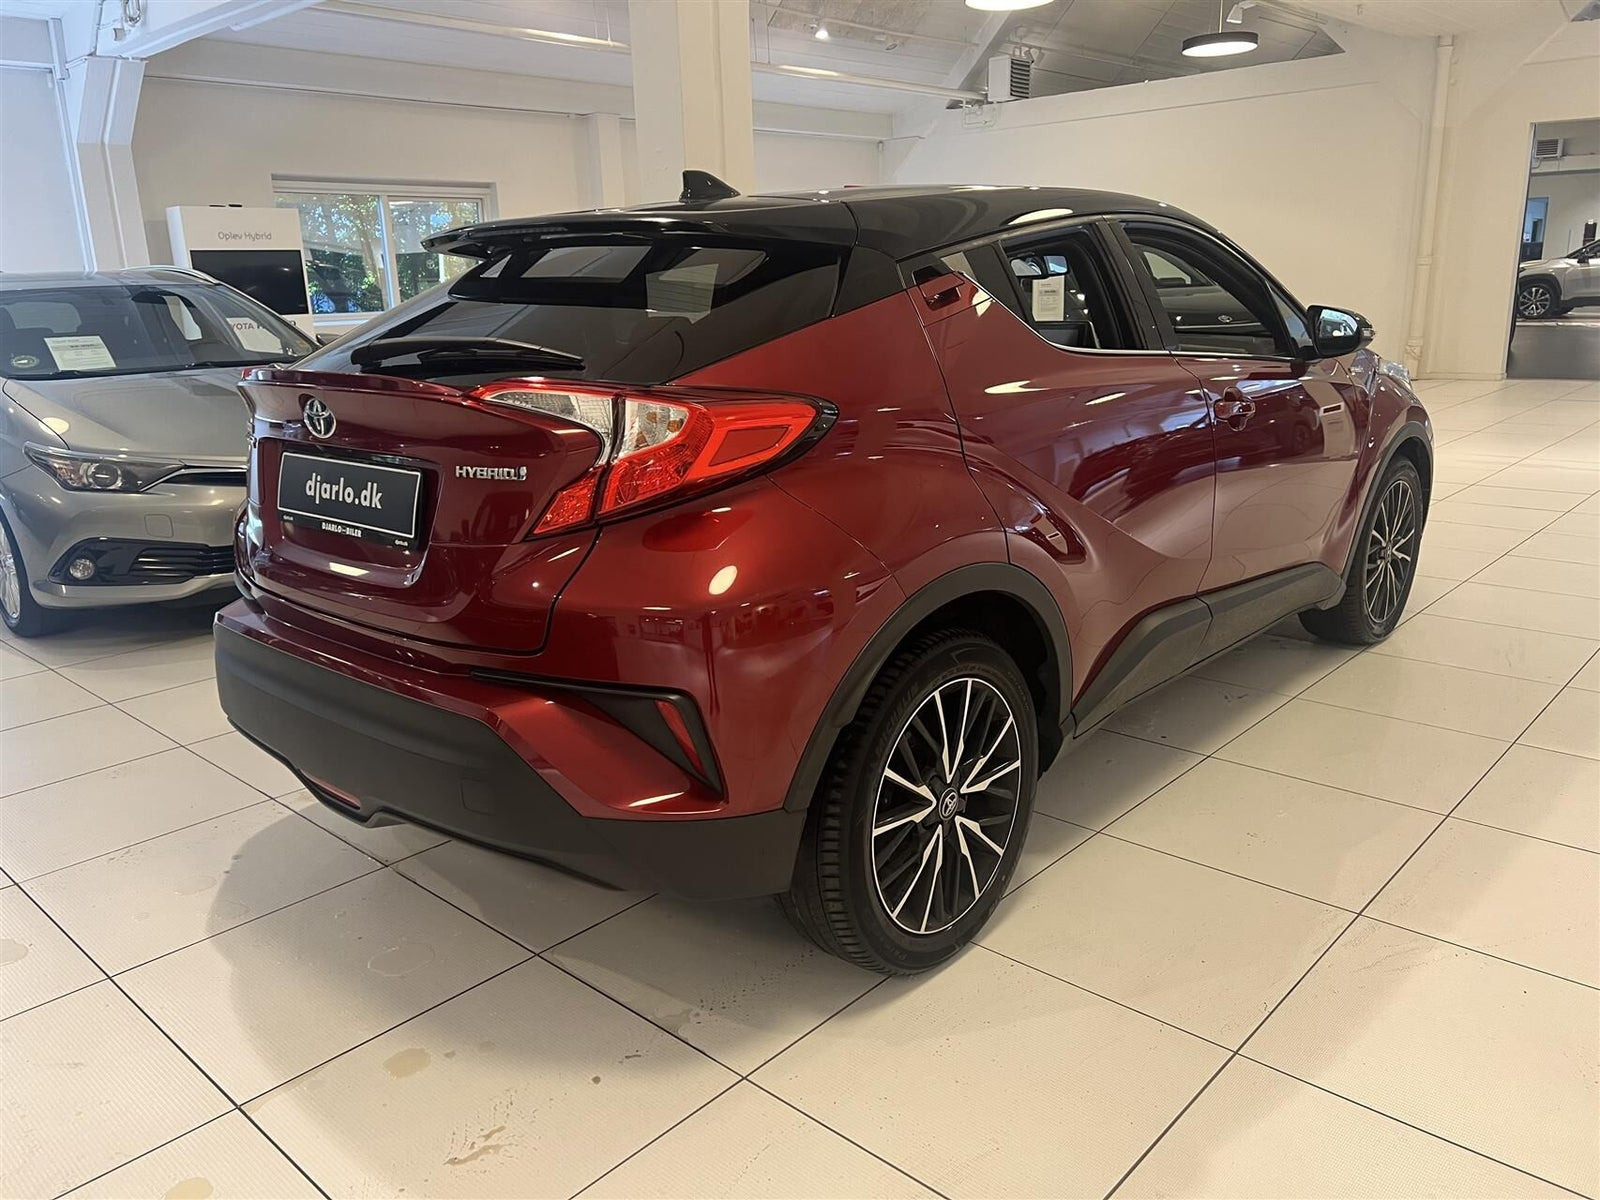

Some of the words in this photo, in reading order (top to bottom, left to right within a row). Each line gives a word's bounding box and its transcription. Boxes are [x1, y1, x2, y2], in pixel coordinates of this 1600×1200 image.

[217, 231, 242, 240] Oplev
[244, 231, 272, 241] Hybrid
[455, 465, 515, 480] HYBRID
[305, 472, 382, 509] djarlo.dk
